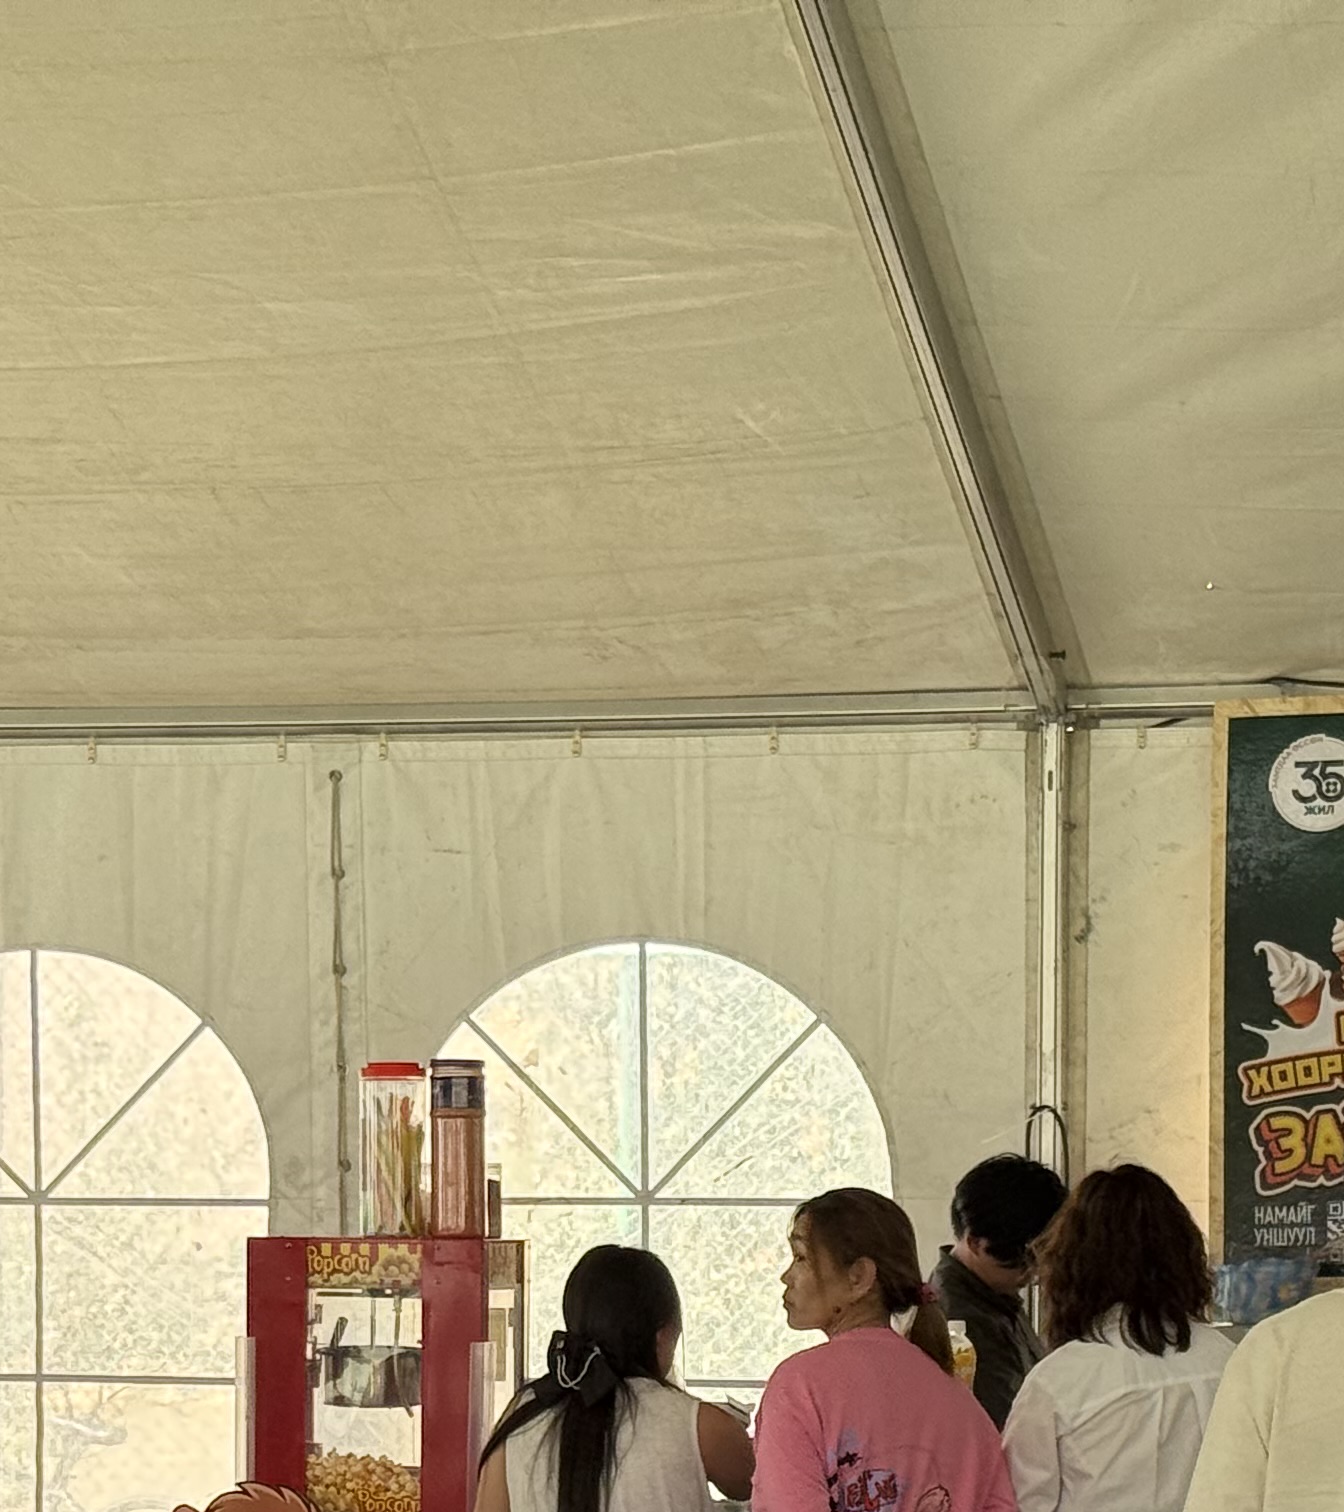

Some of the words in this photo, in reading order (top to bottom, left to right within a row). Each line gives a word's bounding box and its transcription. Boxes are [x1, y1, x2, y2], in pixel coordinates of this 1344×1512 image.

[1303, 804, 1335, 817] ЖИЛ
[1254, 1202, 1316, 1224] НАМАЙГ
[1253, 1227, 1316, 1247] УНШУУЛ
[306, 1245, 370, 1282] Popcorn
